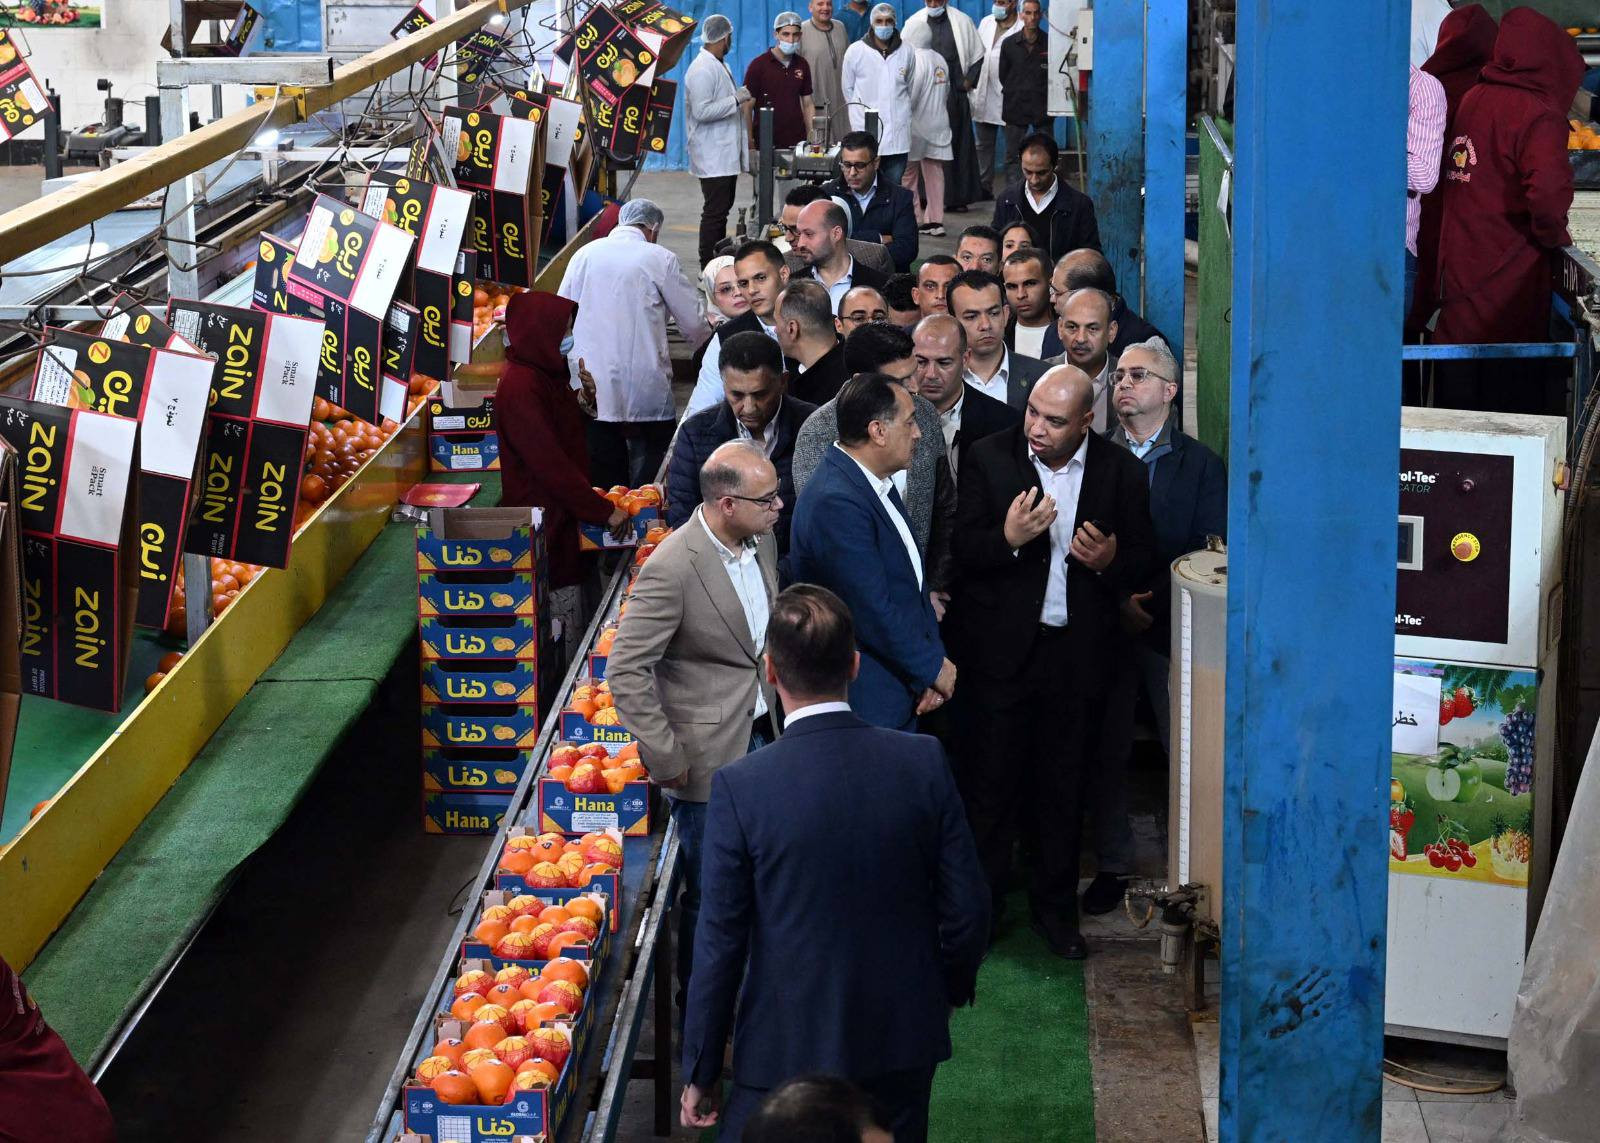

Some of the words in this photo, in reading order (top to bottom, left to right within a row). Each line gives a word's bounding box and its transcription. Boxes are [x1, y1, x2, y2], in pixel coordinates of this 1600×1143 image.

[596, 41, 618, 69] زين
[474, 129, 493, 168] زين
[502, 222, 524, 258] زين
[336, 231, 363, 280] زين
[423, 305, 445, 347] زين
[353, 346, 374, 391] زين
[467, 413, 491, 428] زين
[452, 446, 480, 455] Hana
[95, 467, 107, 498] Smart
[442, 545, 482, 565] هنا
[444, 590, 484, 610] هنا
[446, 634, 486, 654] هنا
[447, 678, 487, 698] هنا
[447, 722, 487, 742] هنا
[593, 728, 632, 742] Hana
[448, 766, 488, 786] هنا
[574, 797, 615, 812] Hana
[445, 811, 489, 829] Hana
[477, 1117, 516, 1136] هنا
